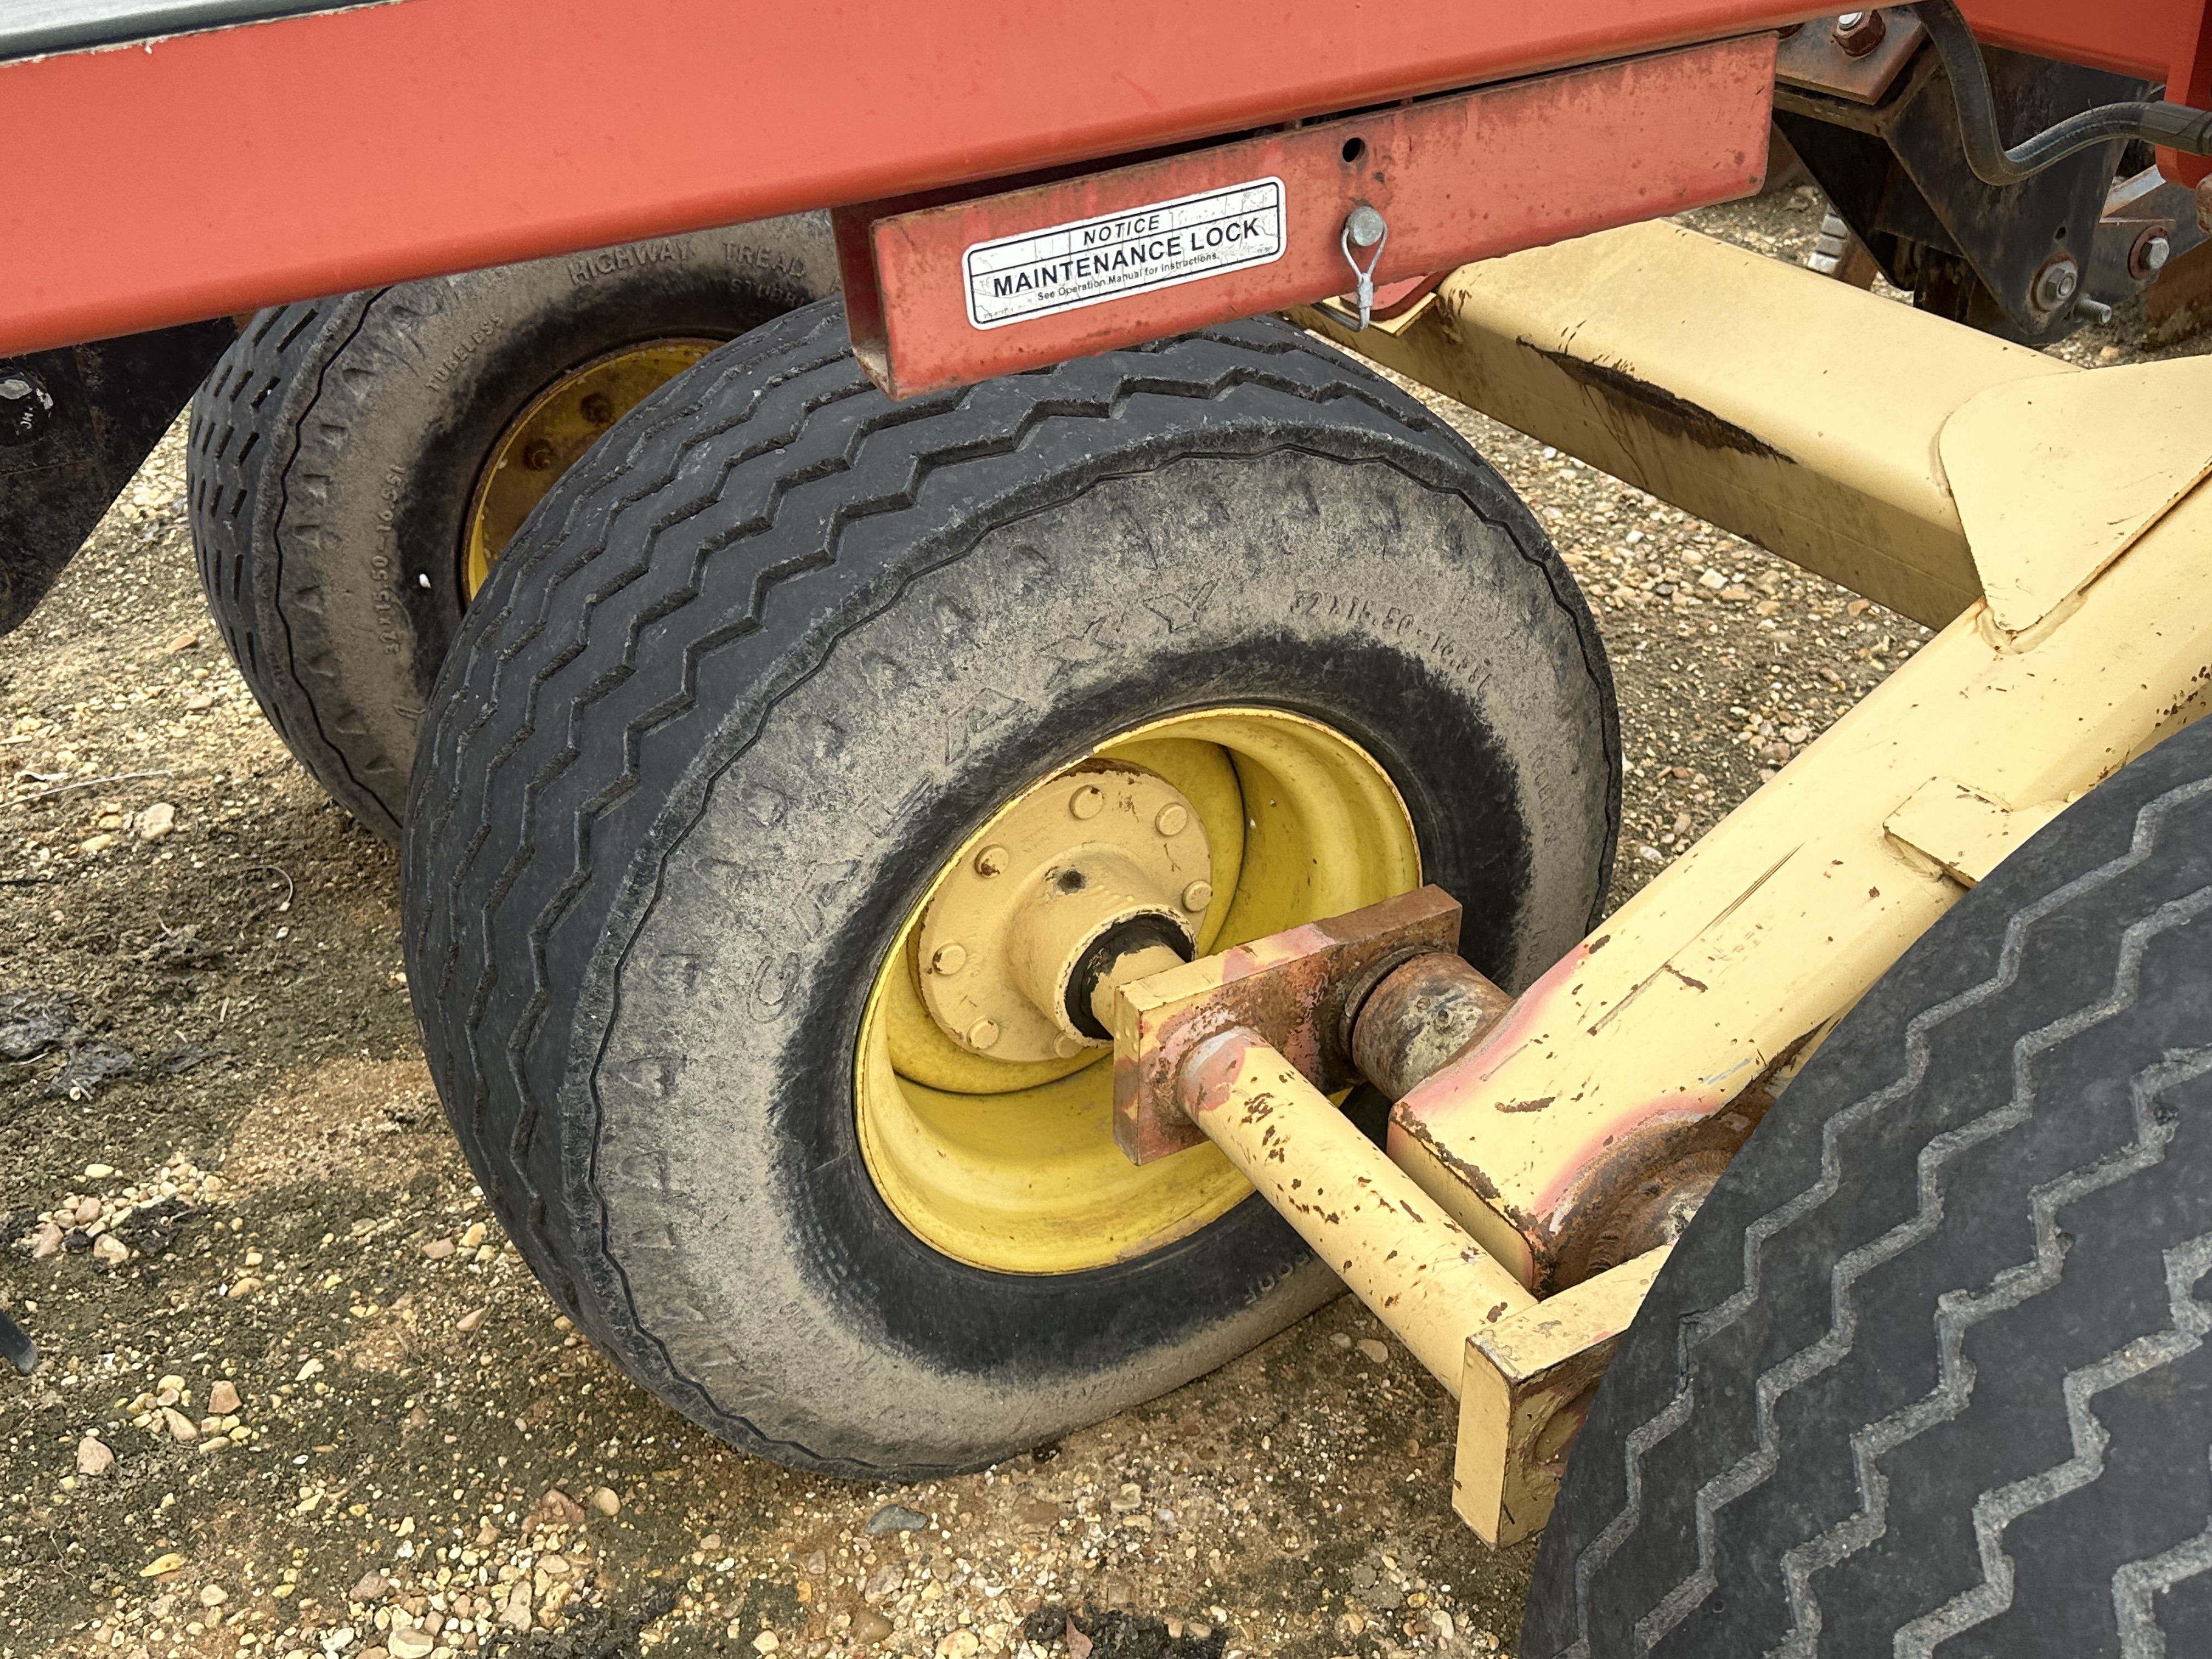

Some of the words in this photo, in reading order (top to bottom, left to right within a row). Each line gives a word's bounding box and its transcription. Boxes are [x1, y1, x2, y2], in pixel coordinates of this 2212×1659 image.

[1084, 215, 1160, 246] NOTICE
[567, 239, 690, 285] HIGHWAY
[722, 242, 805, 277] TREAD
[994, 236, 1182, 297] MAINTENANCE
[1191, 218, 1259, 251] LOCK
[1037, 286, 1055, 301] See
[1058, 279, 1105, 296] Operation
[1108, 269, 1142, 284] Manual
[1144, 267, 1158, 275] for
